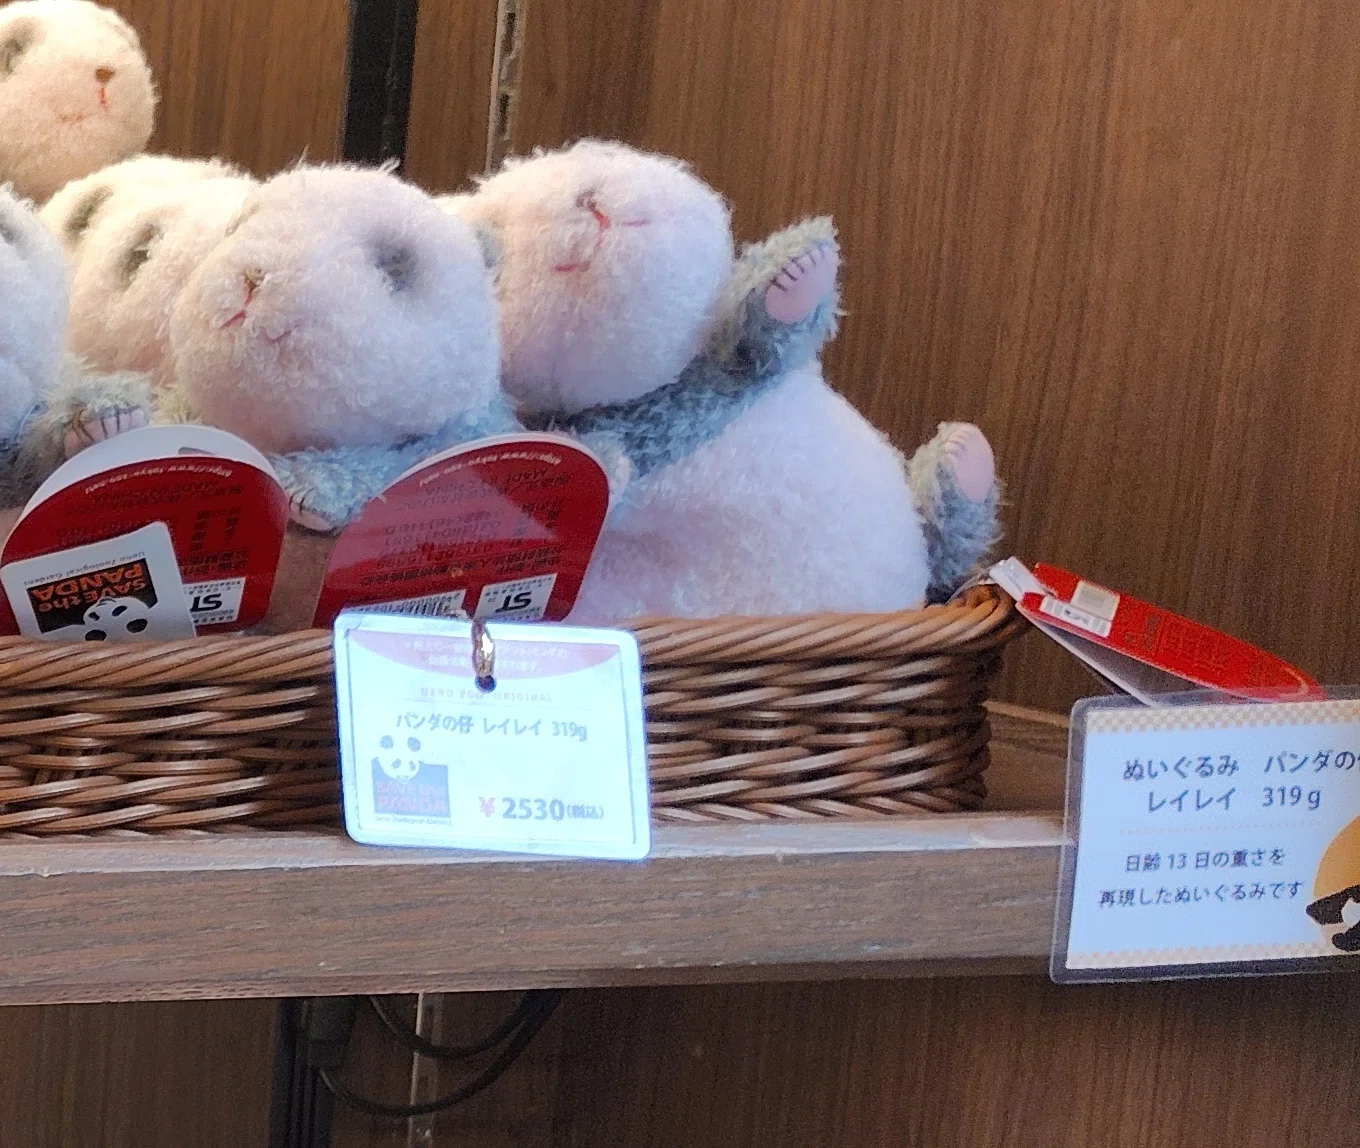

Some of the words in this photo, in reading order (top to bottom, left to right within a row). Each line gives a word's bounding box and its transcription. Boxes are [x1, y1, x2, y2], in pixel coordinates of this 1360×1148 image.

[31, 563, 143, 599] PANDA
[81, 577, 147, 603] SAVE
[38, 593, 82, 613] the
[189, 593, 222, 613] ST
[495, 591, 532, 613] ST
[396, 713, 474, 734] パンダの仔
[483, 717, 542, 736] レイレイ
[551, 720, 588, 742] 319g
[1123, 754, 1239, 782] ぬいぐるみ
[1264, 750, 1360, 773] パンダの
[1148, 788, 1237, 813] レイレイ
[1099, 880, 1304, 909] 再現したぬいぐるみです
